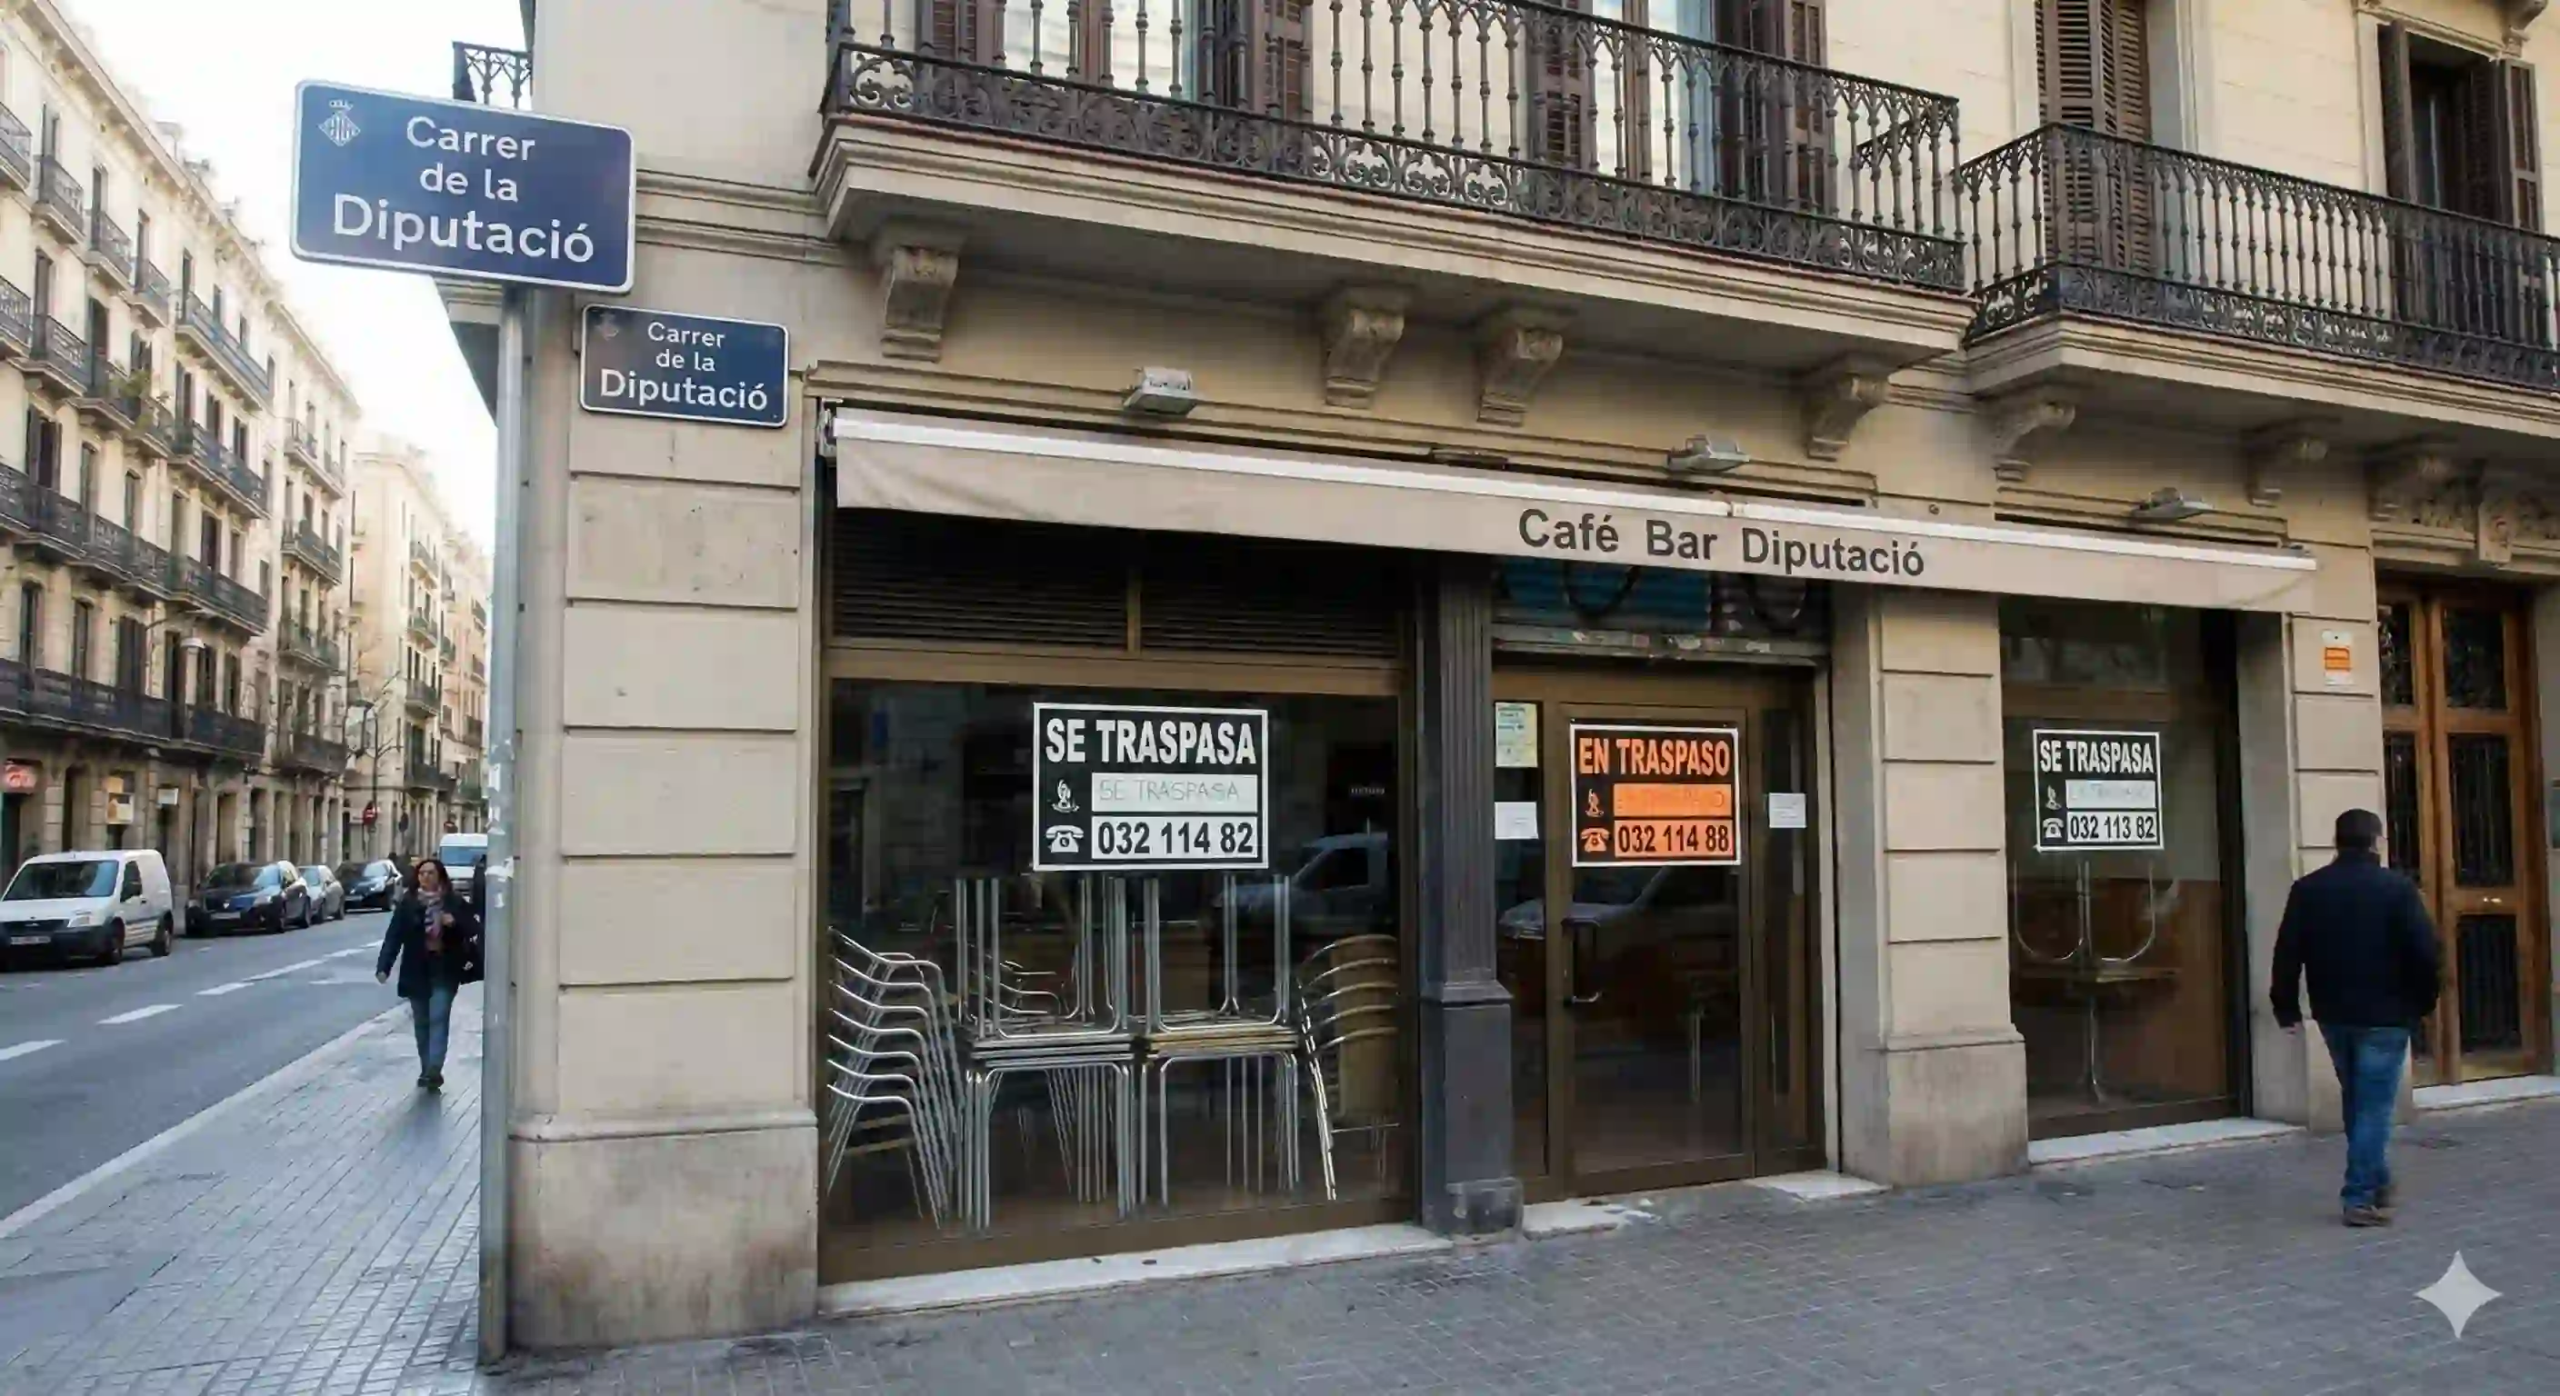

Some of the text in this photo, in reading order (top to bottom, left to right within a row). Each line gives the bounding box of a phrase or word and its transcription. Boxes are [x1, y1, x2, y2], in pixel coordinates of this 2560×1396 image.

[406, 116, 536, 162] Carrer
[419, 163, 519, 203] de la
[333, 193, 595, 263] Diputació
[647, 321, 726, 348] Carrer
[655, 348, 716, 373] de la
[600, 368, 768, 412] Diputació
[1519, 508, 1925, 577] Café Bar Diputació
[1046, 718, 1257, 765] SE TRASPASA
[1579, 737, 1731, 777] EN TRASPASO
[2040, 739, 2154, 774] SE TRASPASA
[1099, 779, 1240, 802] SE TRASPASA
[1098, 822, 1254, 855] 032 114 82
[1618, 825, 1730, 853] 032 114 88
[2070, 814, 2156, 840] 032 113 82
